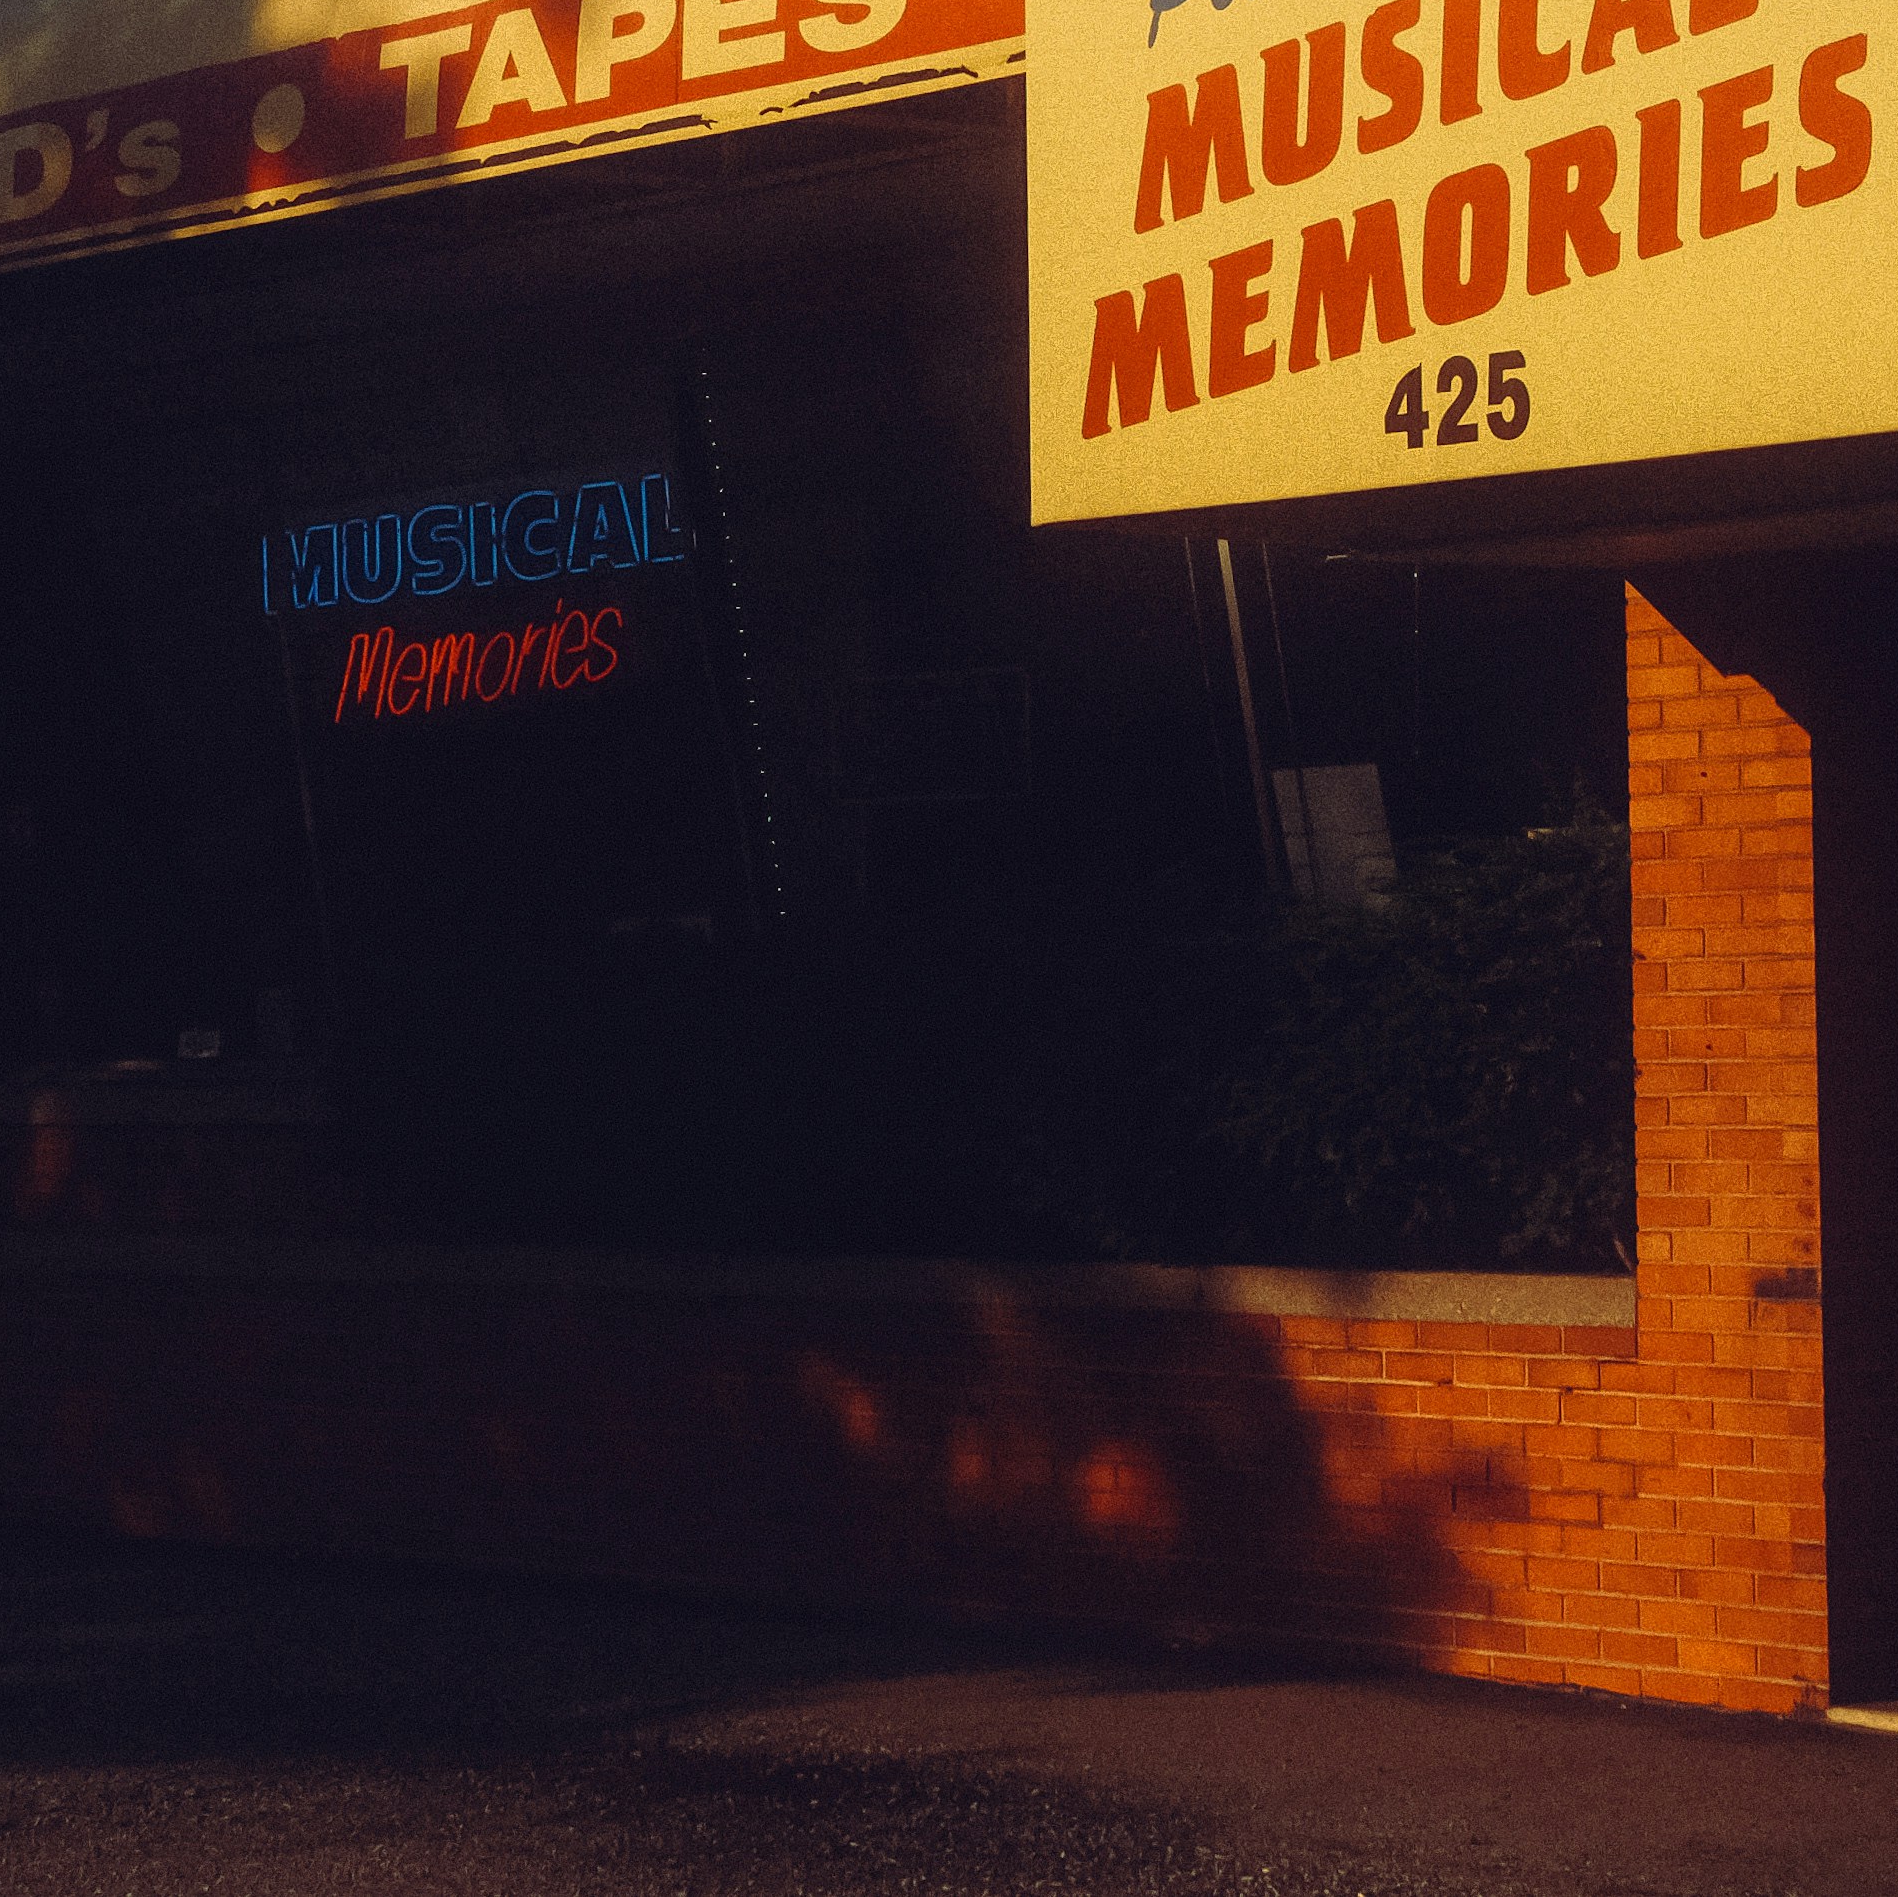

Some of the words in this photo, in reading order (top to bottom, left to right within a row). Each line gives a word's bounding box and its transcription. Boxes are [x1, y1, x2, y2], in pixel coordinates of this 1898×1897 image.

[1082, 33, 1873, 440] MEMORIES
[1384, 350, 1532, 450] 425
[262, 473, 697, 615] MUSICAL
[334, 598, 624, 724] Memories
